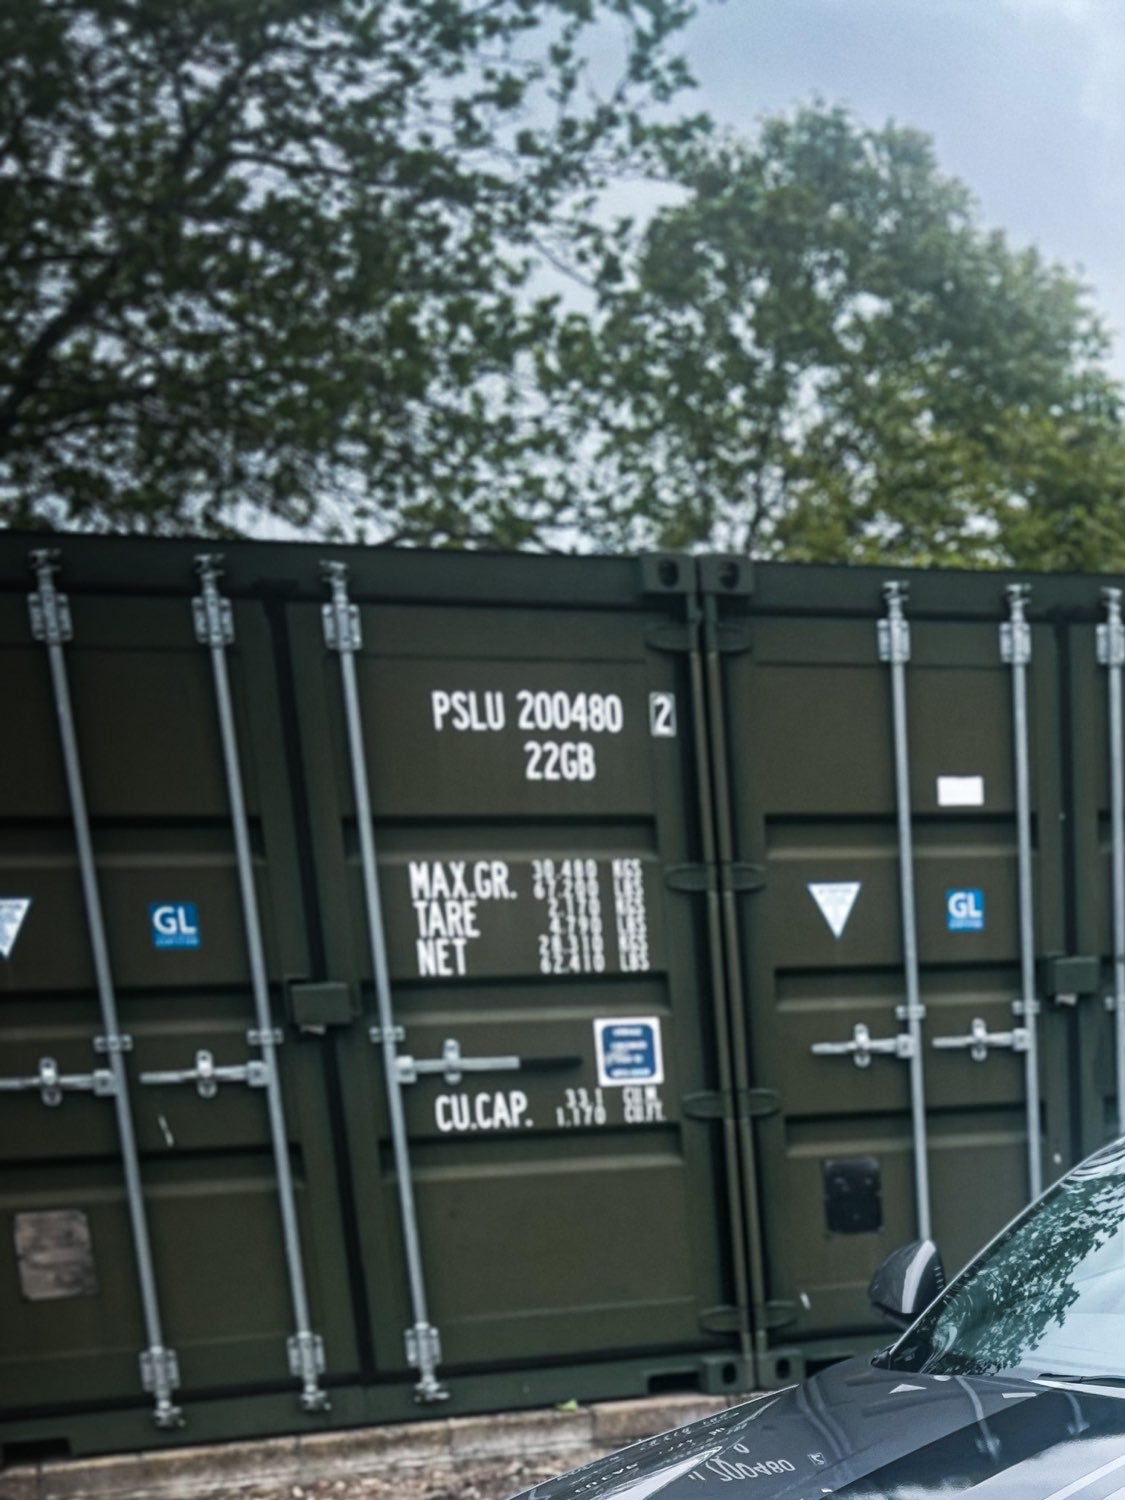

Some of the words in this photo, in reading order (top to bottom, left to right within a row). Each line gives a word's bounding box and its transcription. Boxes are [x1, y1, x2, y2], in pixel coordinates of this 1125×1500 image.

[431, 690, 505, 731] PSLU
[516, 690, 623, 733] 200480
[651, 694, 674, 736] 2
[524, 741, 596, 781] 22GB
[409, 861, 517, 899] MAX.GR.
[153, 905, 197, 935] GL
[413, 900, 480, 937] TARE
[948, 892, 983, 918] GL
[416, 938, 467, 976] NET
[435, 1090, 534, 1131] CU.CAP.
